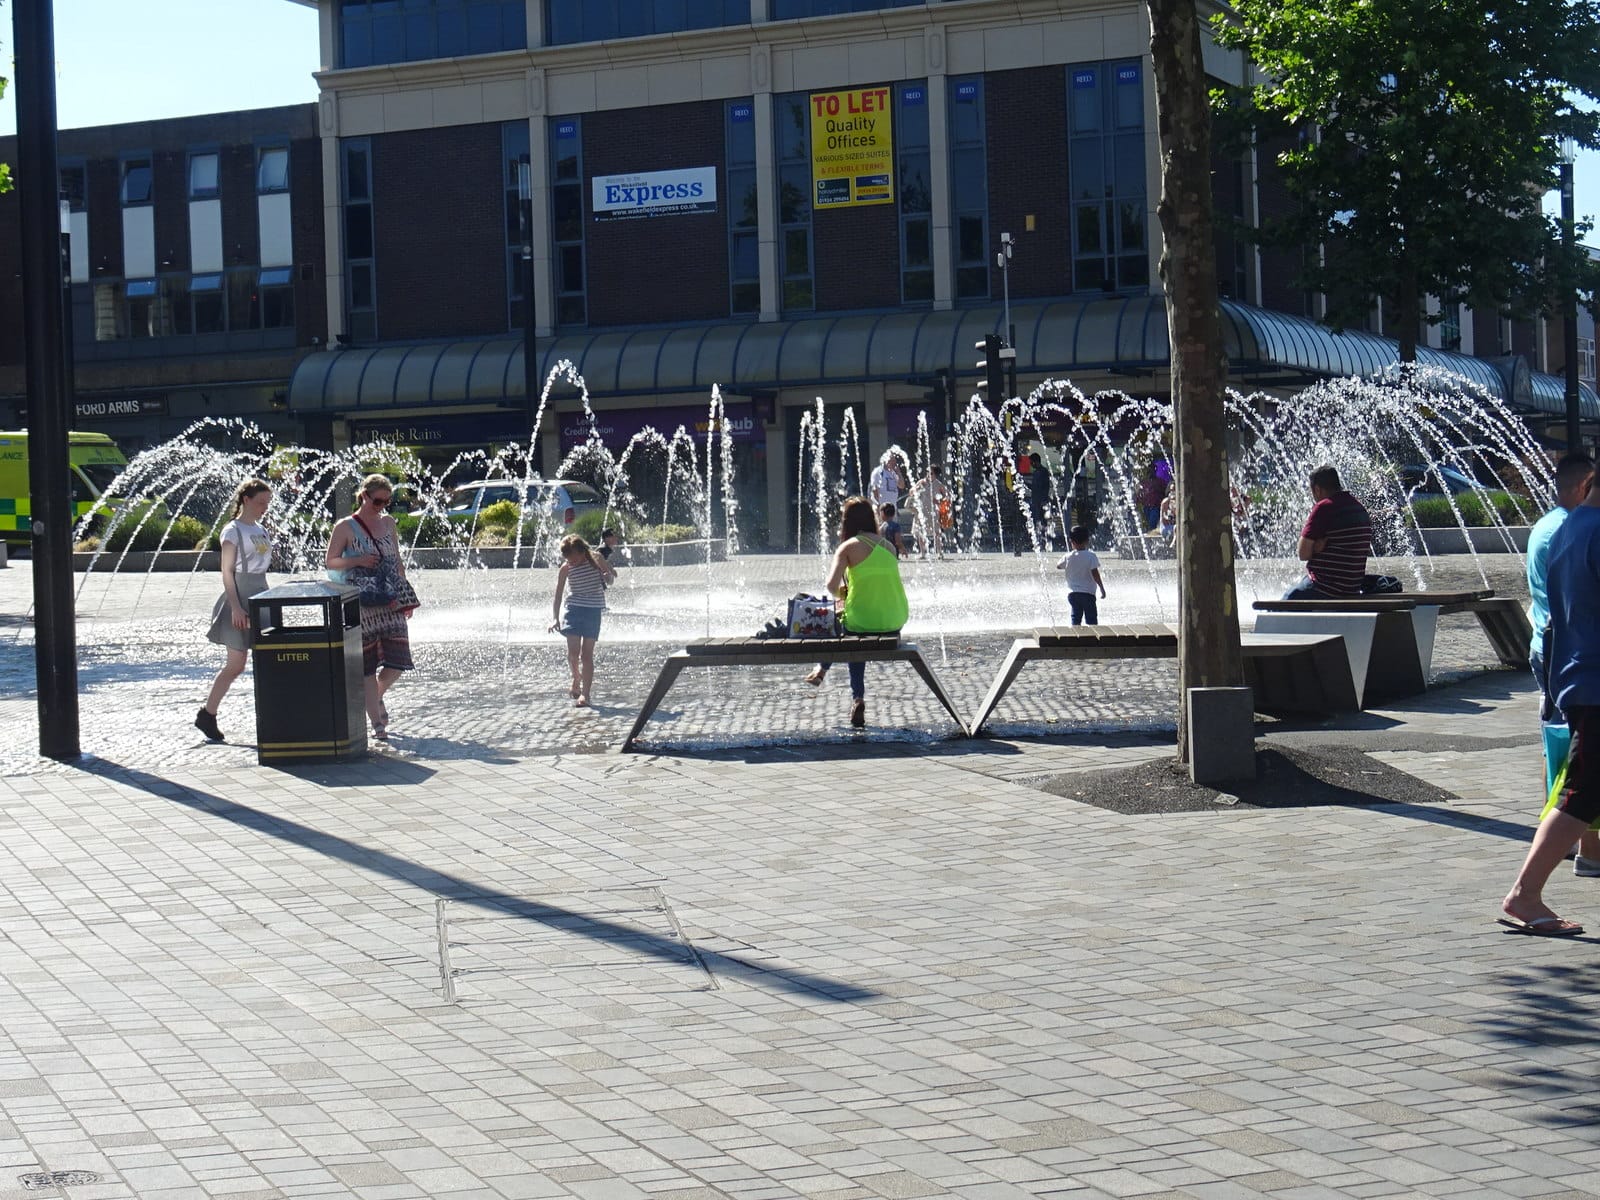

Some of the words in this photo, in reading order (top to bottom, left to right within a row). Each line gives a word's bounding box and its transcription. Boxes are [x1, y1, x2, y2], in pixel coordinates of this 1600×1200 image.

[1075, 74, 1092, 83] REED
[813, 95, 840, 117] TO
[847, 89, 888, 114] LET
[826, 116, 876, 133] Quality
[827, 134, 876, 150] Offices
[814, 154, 844, 163] VARIOUS
[845, 152, 865, 162] SIZED
[866, 150, 890, 160] SUITES
[827, 163, 859, 174] FLEXIBLE
[604, 182, 704, 206] Express
[107, 400, 140, 415] ARMS
[370, 428, 405, 442] Reeds
[408, 427, 442, 441] Rains
[563, 426, 589, 436] Credit
[276, 652, 311, 662] LITTER
